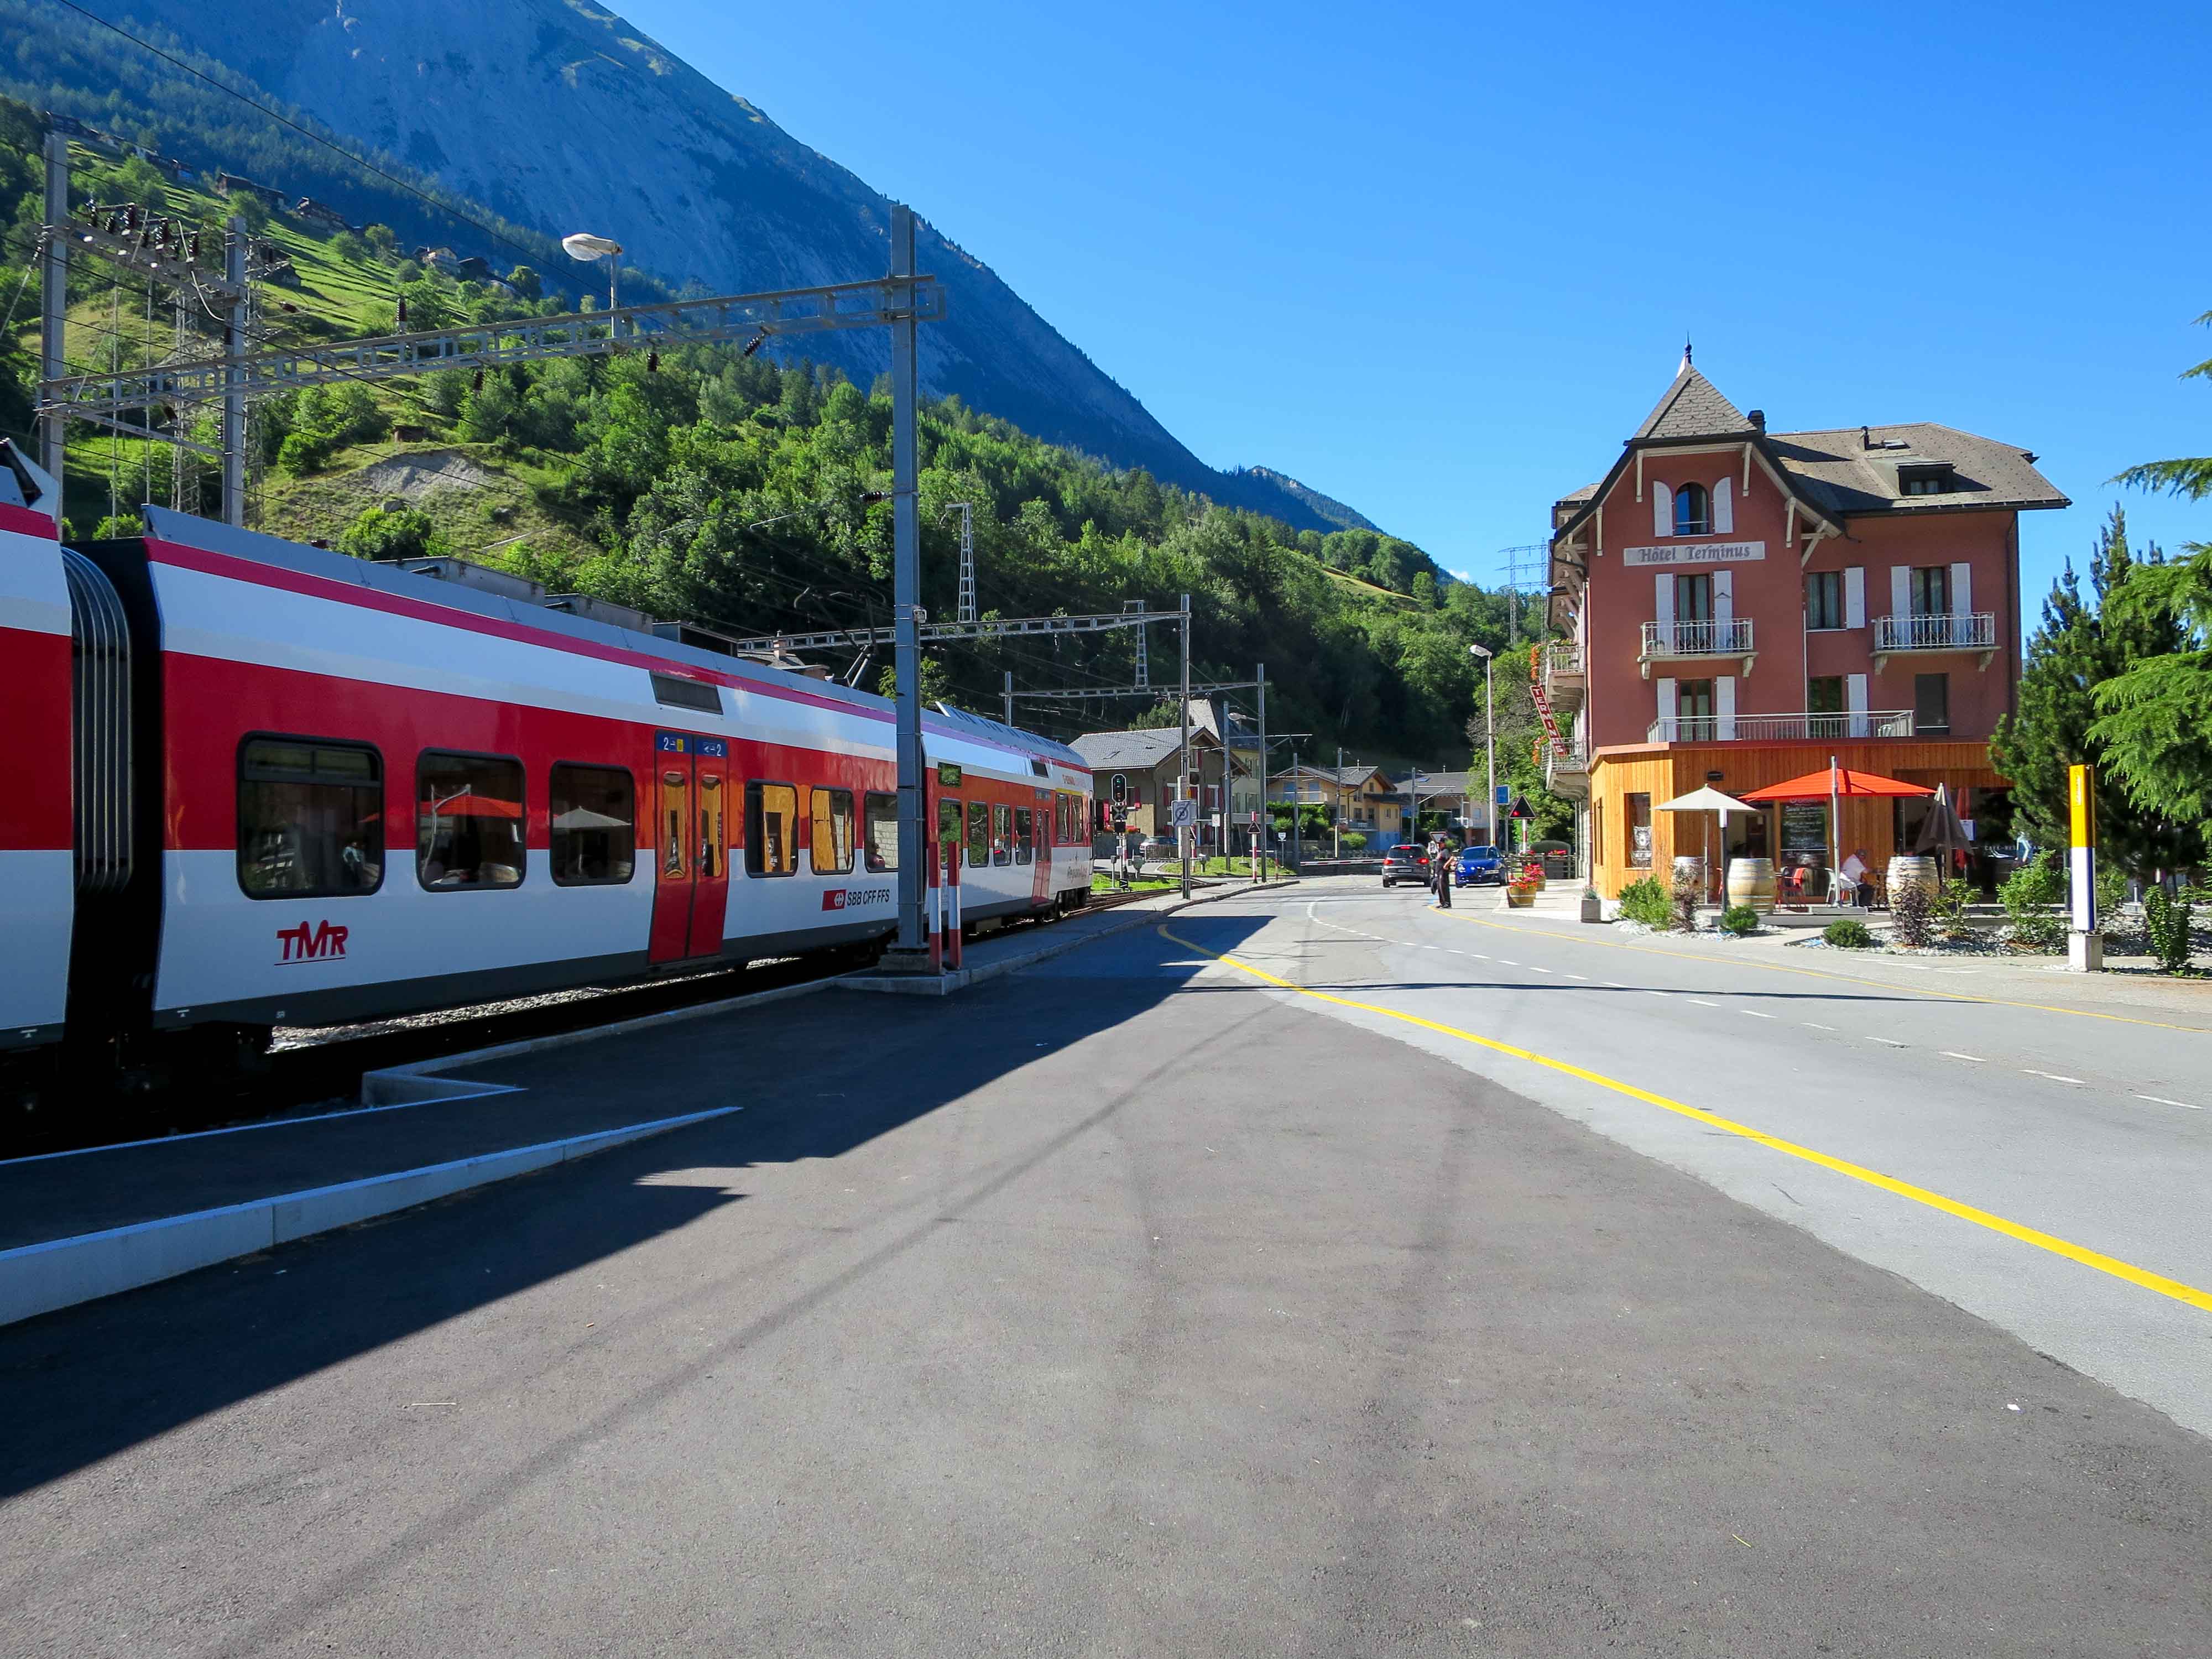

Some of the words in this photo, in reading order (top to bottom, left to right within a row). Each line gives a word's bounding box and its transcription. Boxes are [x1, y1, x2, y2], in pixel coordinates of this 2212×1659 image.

[1638, 545, 1677, 562] Hôtel
[1685, 544, 1751, 560] Terminus
[664, 737, 669, 750] 2
[716, 743, 722, 757] 2
[847, 891, 862, 906] SBB
[863, 890, 877, 905] CFF
[877, 889, 890, 903] FFS
[276, 920, 348, 961] TMR
